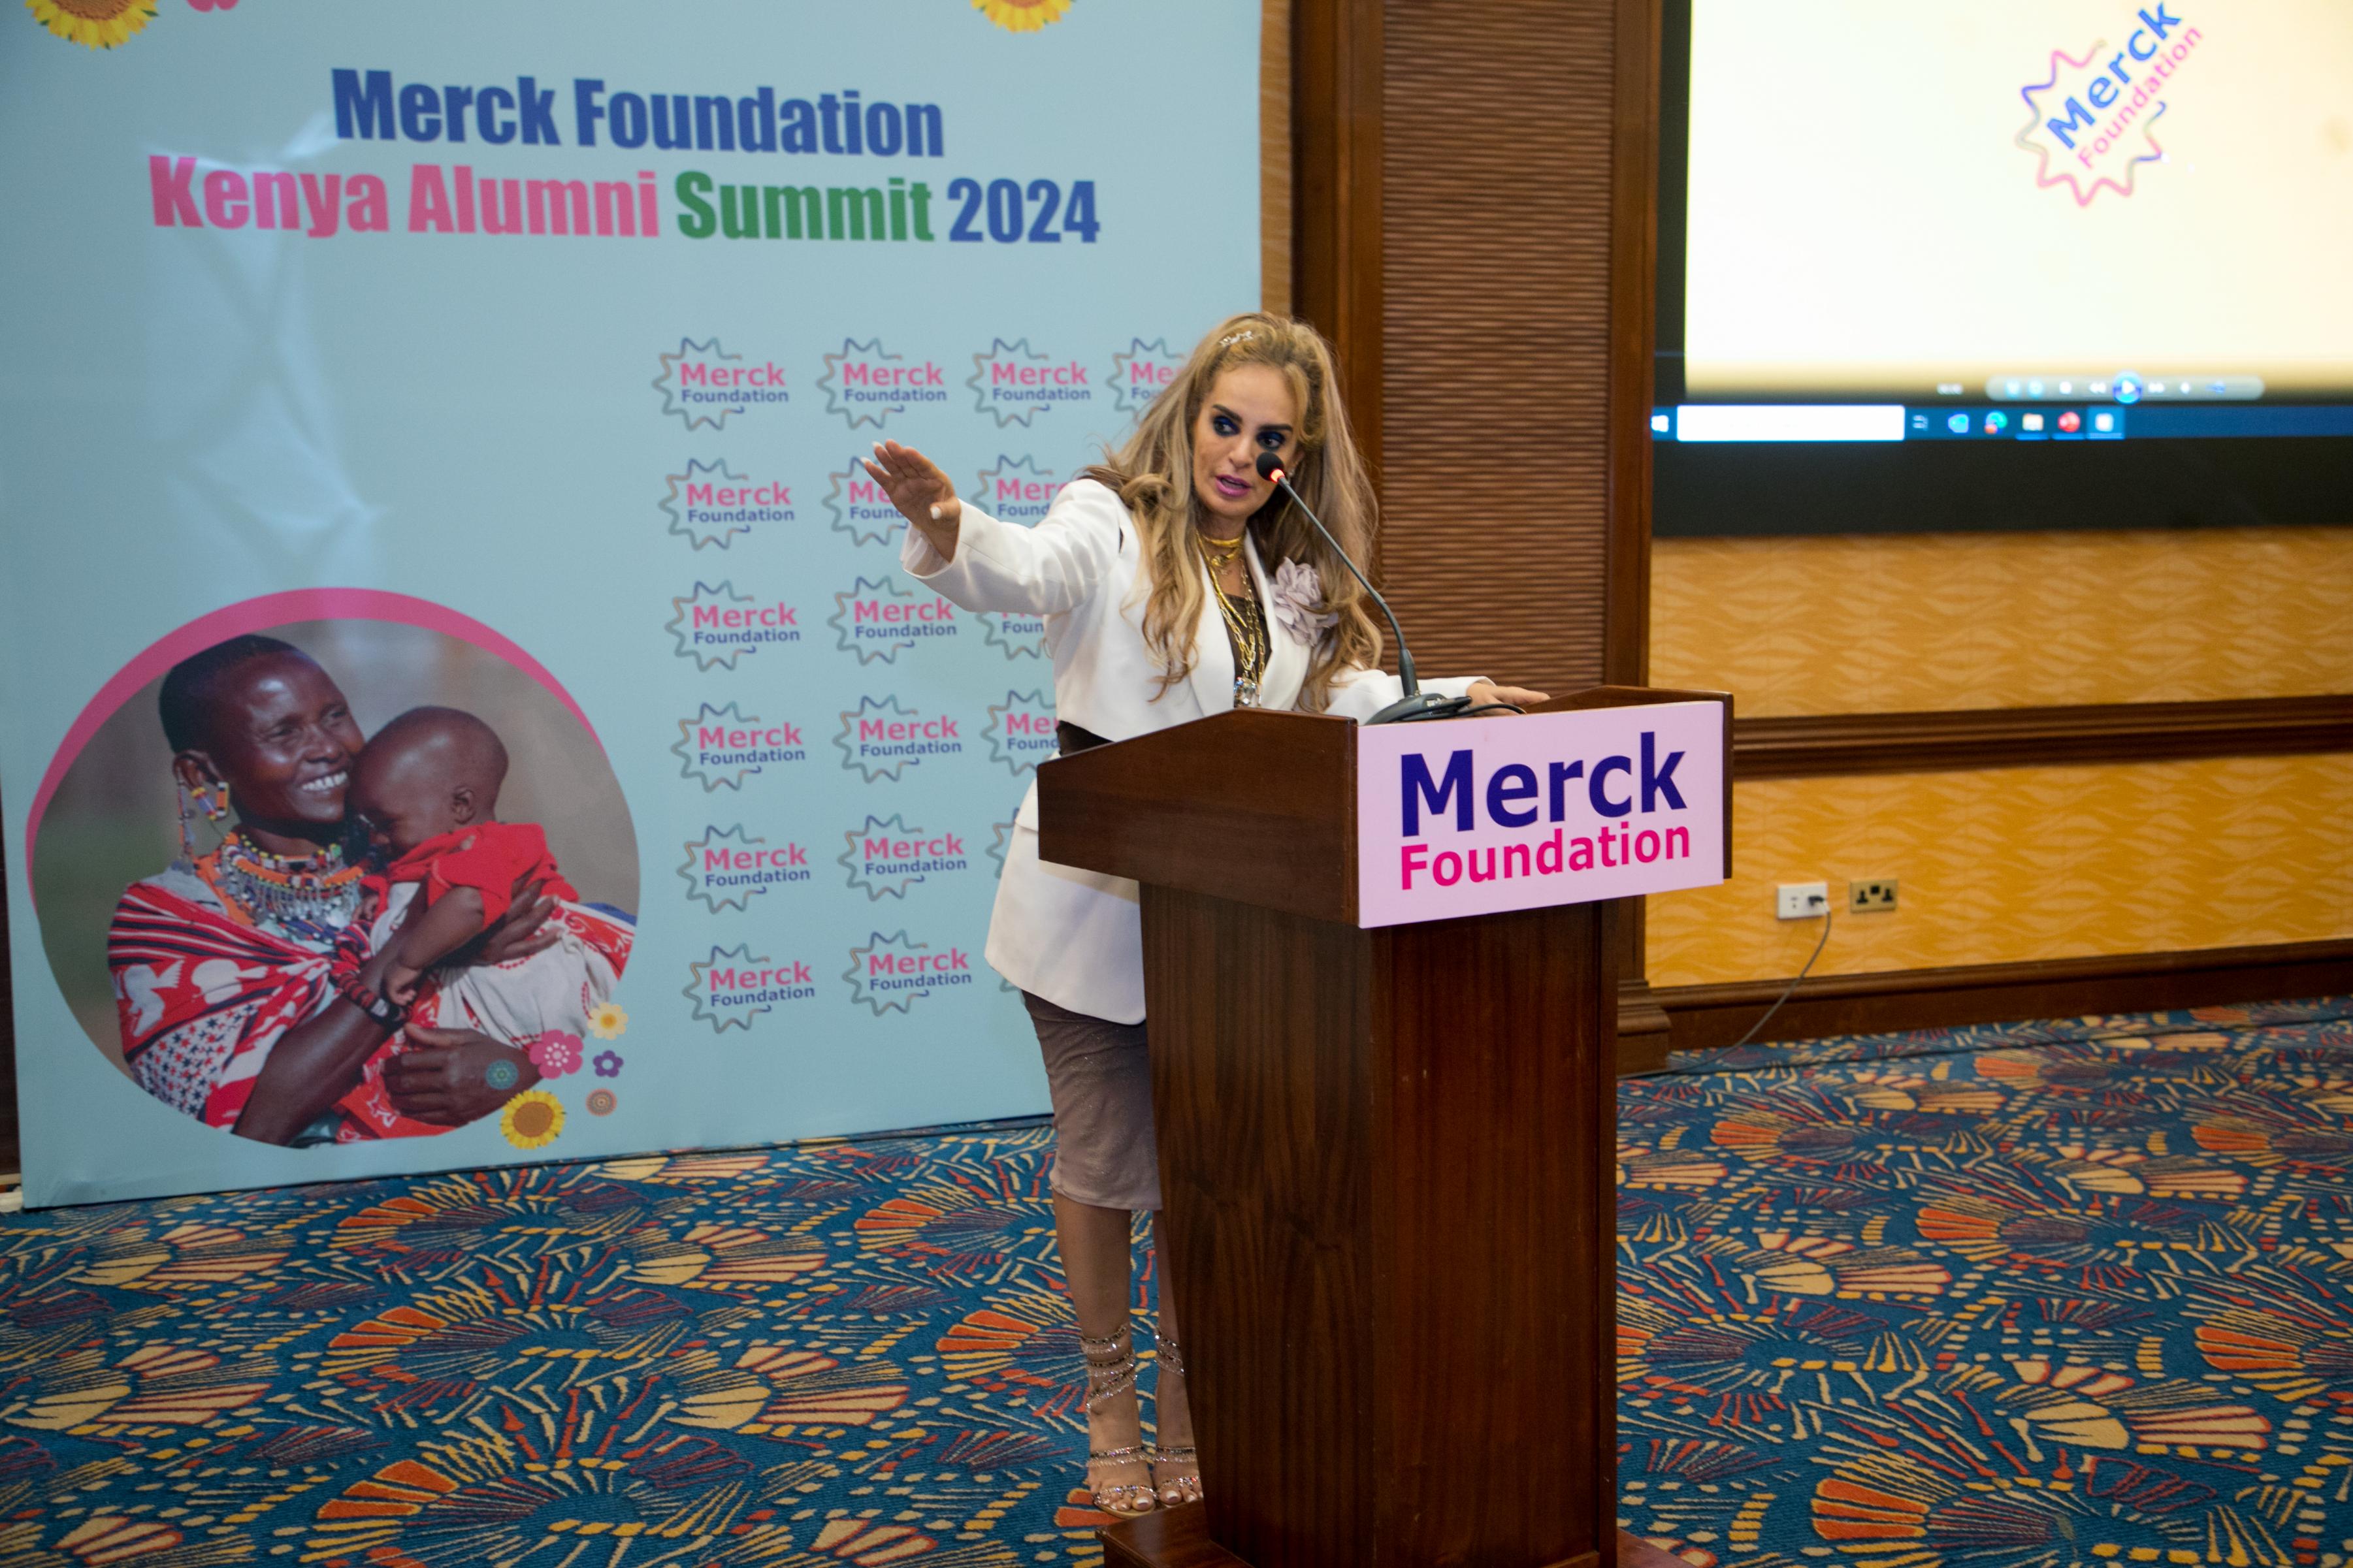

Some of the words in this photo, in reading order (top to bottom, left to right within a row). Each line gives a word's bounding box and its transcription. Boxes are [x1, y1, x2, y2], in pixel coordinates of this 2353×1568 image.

[2047, 1, 2183, 150] Merck
[2077, 27, 2203, 169] Foundation
[331, 68, 560, 146] Merck
[574, 78, 944, 157] Foundation
[149, 155, 389, 239] Kenya
[408, 164, 659, 237] Alumni
[675, 171, 934, 242] Summit
[948, 178, 1100, 243] 2024
[680, 362, 786, 387] Merck
[843, 362, 943, 386] Merck
[992, 362, 1088, 385] Merck
[681, 389, 788, 403] Foundation
[844, 389, 946, 402] Foundation
[993, 388, 1090, 400] Foundation
[687, 481, 791, 507] Merck
[997, 478, 1067, 501] Mer
[688, 508, 794, 523] Foundation
[692, 602, 797, 629] Merck
[854, 598, 954, 623] Merck
[694, 629, 800, 645] Foundation
[855, 624, 957, 639] Foundation
[698, 722, 803, 750] Merck
[859, 716, 959, 742] Merck
[700, 749, 805, 765] Foundation
[860, 741, 962, 758] Foundation
[1401, 731, 1687, 837] Merck
[704, 843, 808, 871] Merck
[864, 833, 964, 860] Merck
[1401, 822, 1691, 890] Foundation
[706, 869, 810, 888] Foundation
[866, 858, 967, 876] Foundation
[869, 948, 969, 976] Merck
[709, 961, 812, 992] Merck
[870, 972, 971, 991] Foundation
[711, 986, 815, 1007] Foundation
